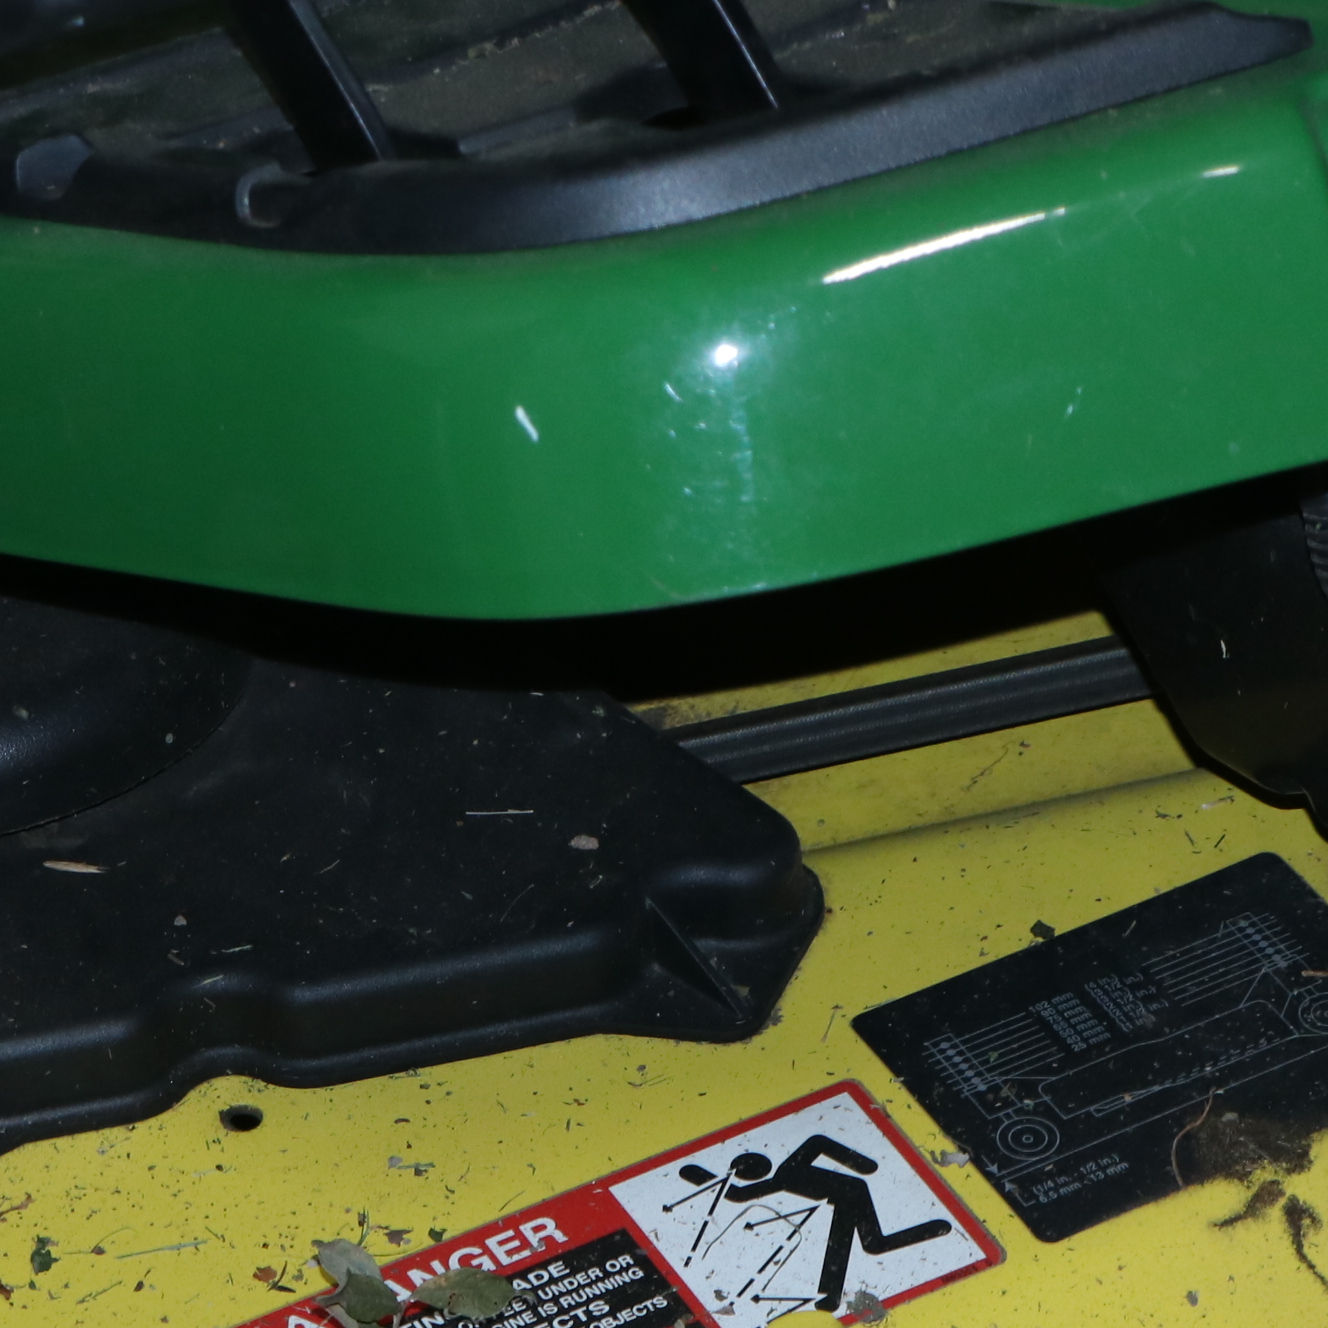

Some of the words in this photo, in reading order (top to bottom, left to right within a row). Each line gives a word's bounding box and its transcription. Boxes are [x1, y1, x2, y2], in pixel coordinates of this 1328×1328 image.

[1051, 992, 1074, 1004] mm
[1057, 999, 1080, 1010] mm
[1064, 1005, 1086, 1017] mm
[1070, 1012, 1093, 1024] mm
[1076, 1019, 1098, 1031] mm
[1082, 1025, 1105, 1037] mm
[1088, 1032, 1111, 1044] mm
[1059, 1182, 1082, 1195] mm
[1106, 1162, 1129, 1175] mm
[383, 1216, 569, 1303] NGER
[537, 1268, 604, 1301] UNDER
[605, 1254, 635, 1273] OR
[537, 1301, 558, 1318] IS
[560, 1268, 645, 1309] RUNNING
